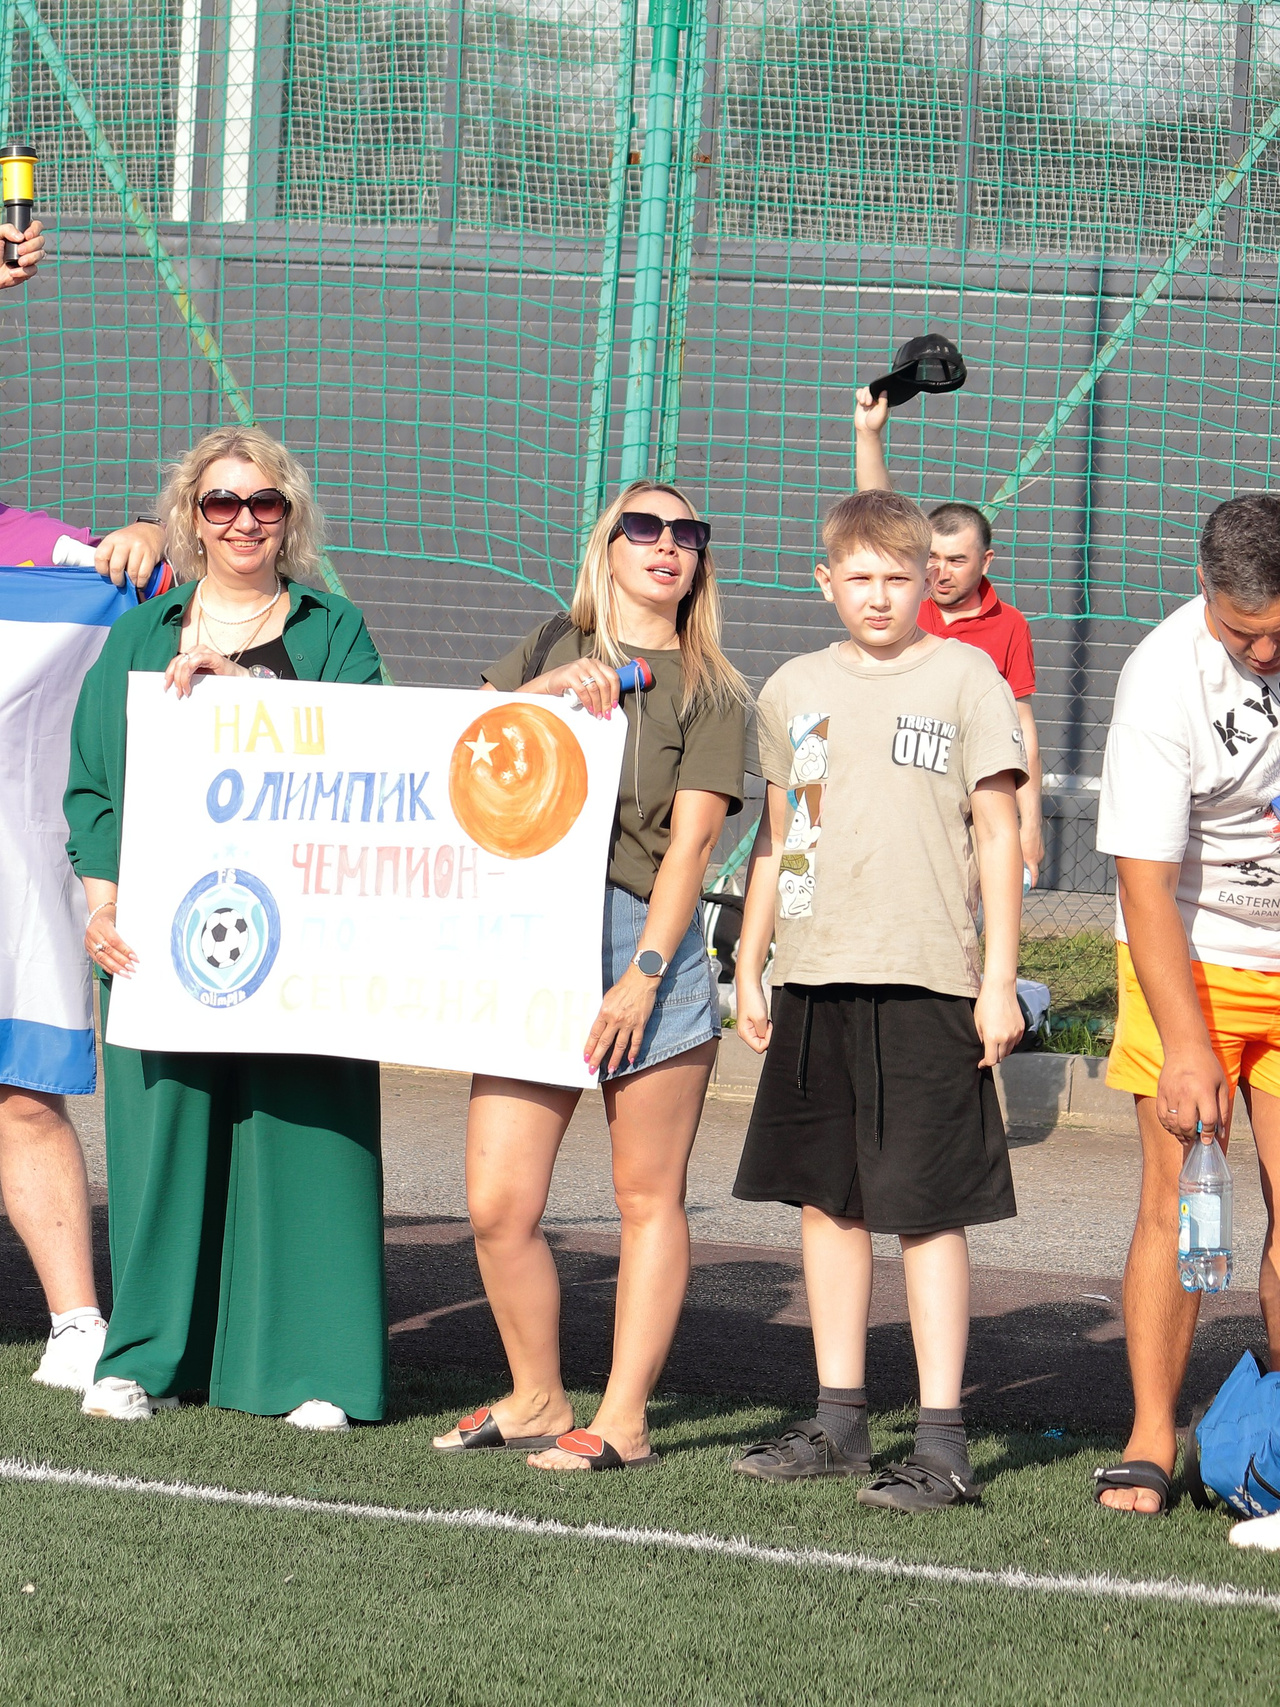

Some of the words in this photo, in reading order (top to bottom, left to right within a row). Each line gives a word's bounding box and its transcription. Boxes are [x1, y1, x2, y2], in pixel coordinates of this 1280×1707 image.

[214, 699, 326, 756] НАШ
[897, 714, 941, 736] TRUST
[940, 720, 957, 739] NO
[892, 728, 951, 775] ONE
[1218, 891, 1280, 909] EASTERN
[1249, 909, 1280, 917] JAPAN
[300, 914, 546, 959] ПОДИТ
